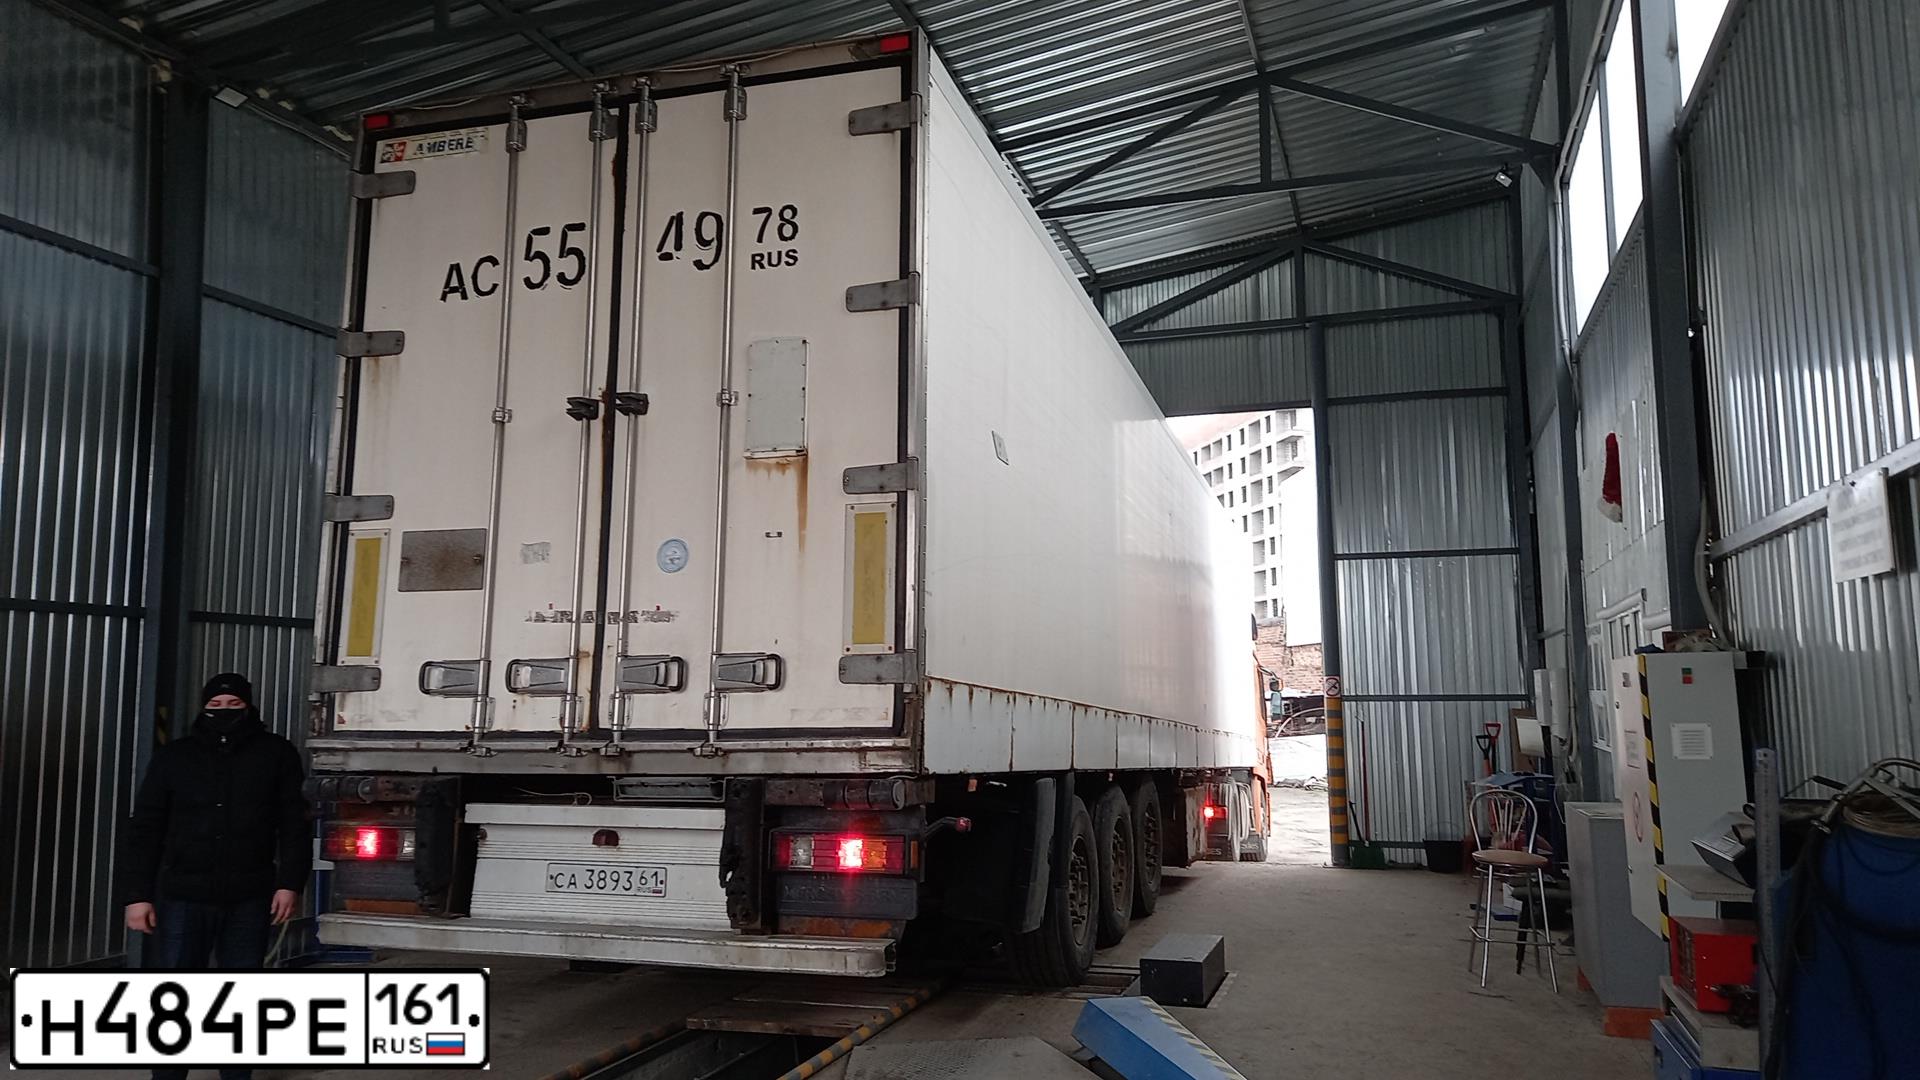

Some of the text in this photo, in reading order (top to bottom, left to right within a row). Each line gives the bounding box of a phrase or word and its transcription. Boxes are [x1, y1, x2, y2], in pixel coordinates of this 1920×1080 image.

[523, 222, 586, 290] 55
[656, 211, 724, 271] 49
[752, 204, 799, 244] 78
[751, 249, 799, 270] RUS
[639, 870, 659, 887] 61
